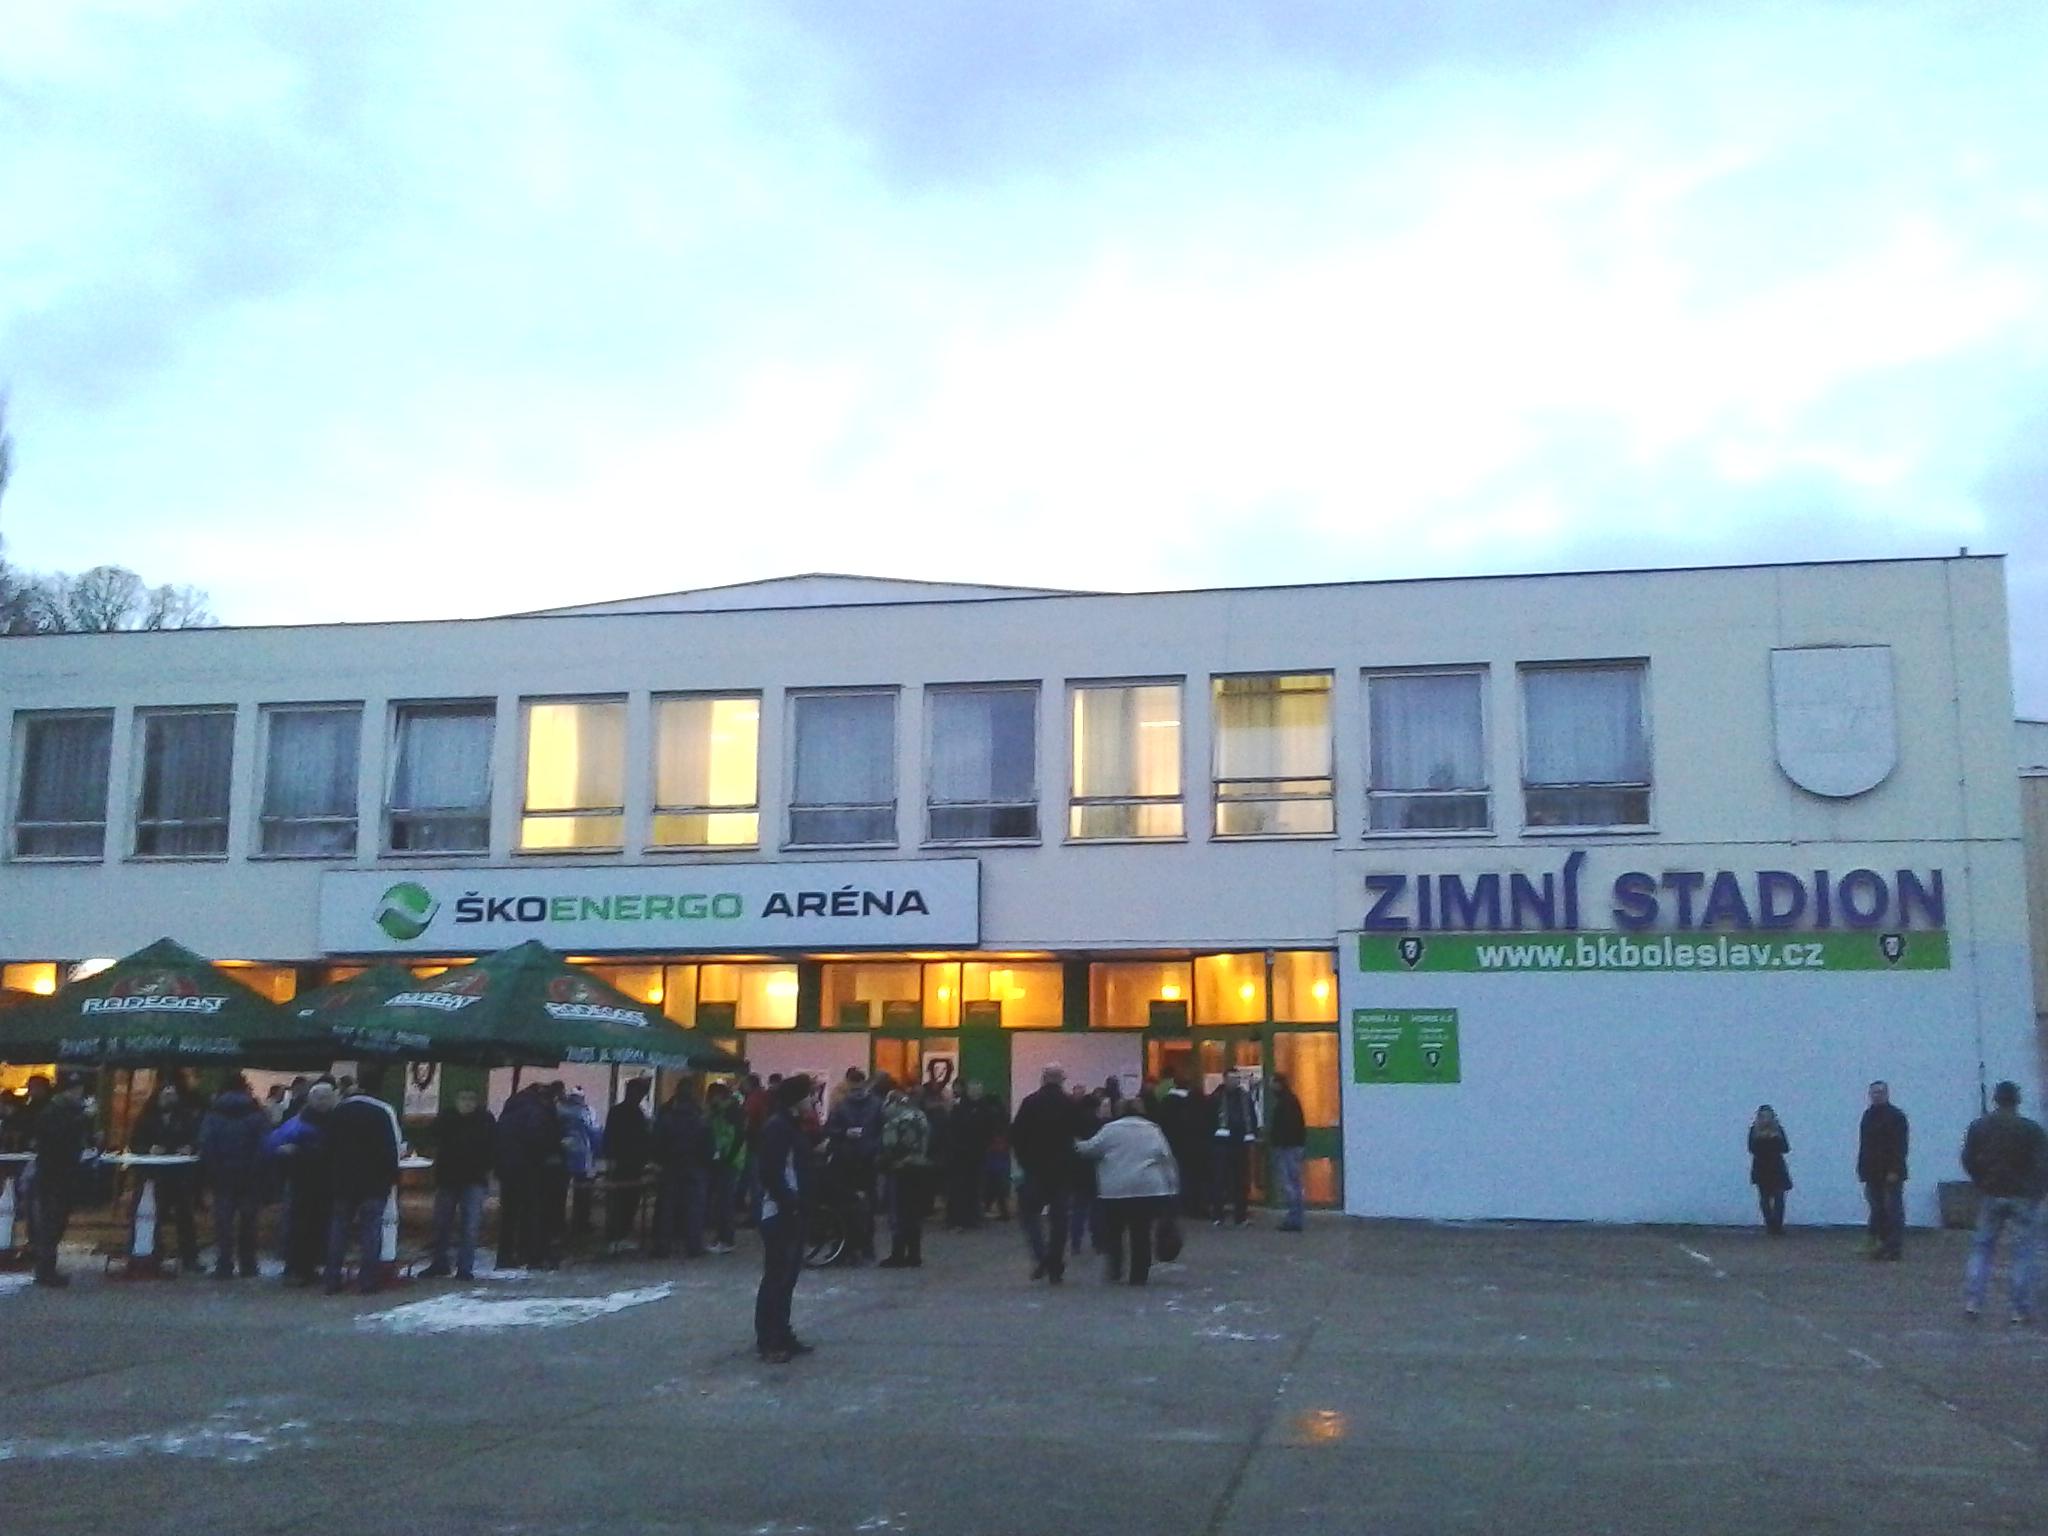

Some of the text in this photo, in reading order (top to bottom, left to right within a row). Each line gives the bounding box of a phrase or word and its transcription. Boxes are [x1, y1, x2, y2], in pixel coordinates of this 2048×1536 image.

[455, 885, 930, 923] ŠKOENERGO ARÉNA
[1364, 850, 1946, 930] ZIMNÍ STADION
[1476, 936, 1825, 968] www.bkboleslav.cz
